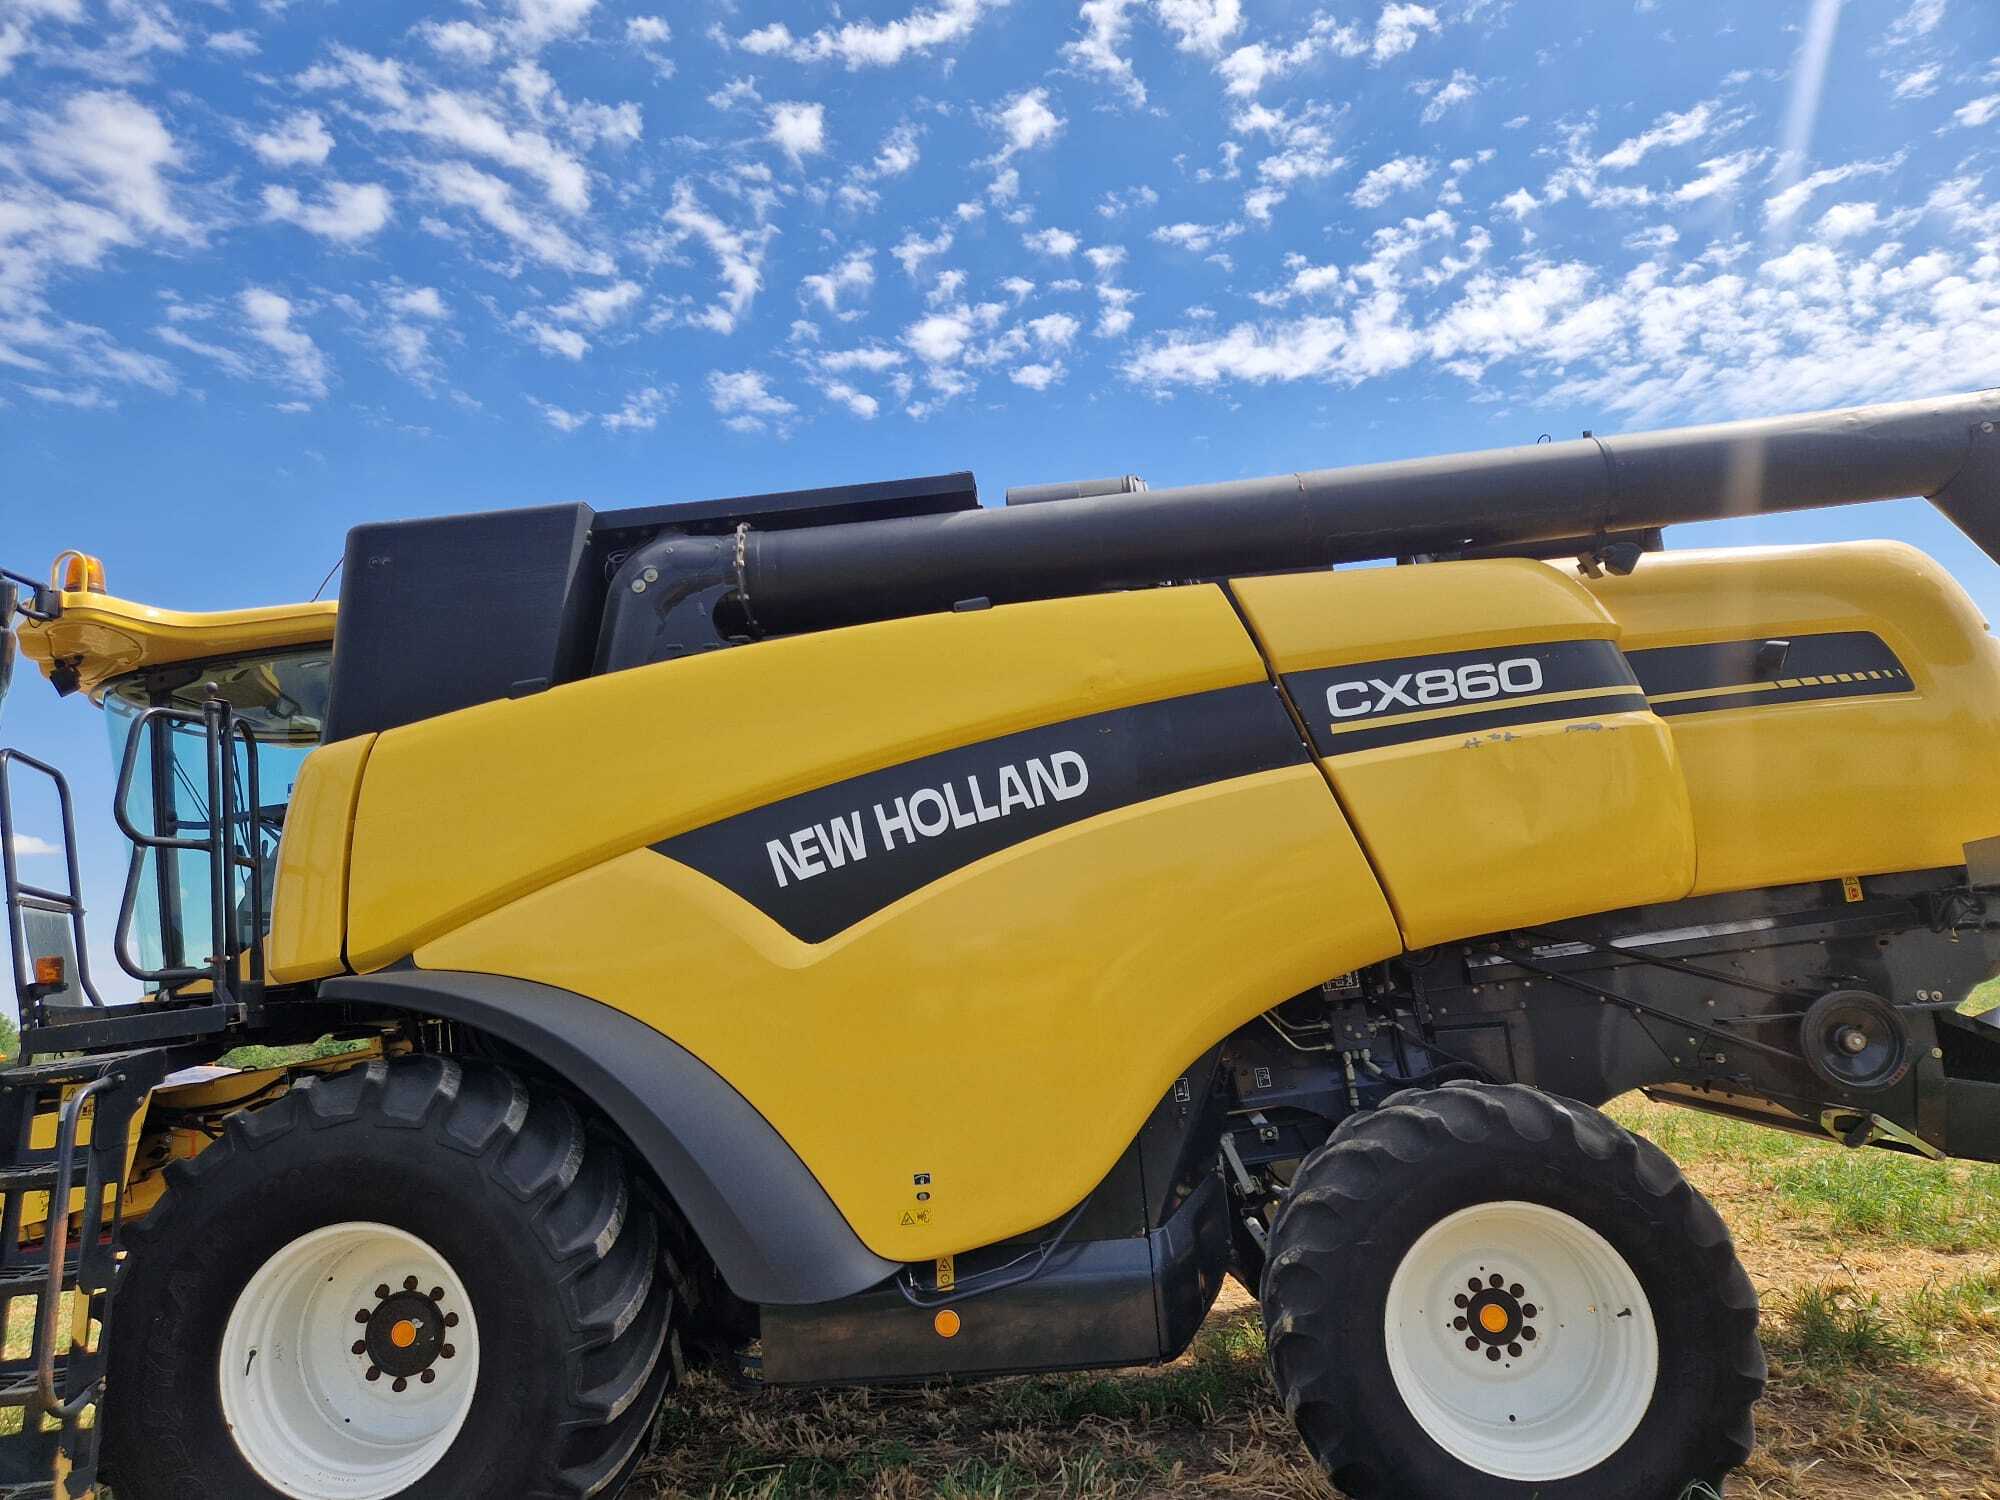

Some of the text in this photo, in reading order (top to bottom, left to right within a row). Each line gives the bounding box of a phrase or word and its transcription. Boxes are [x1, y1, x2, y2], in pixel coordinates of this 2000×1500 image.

[1326, 658, 1543, 717] CX860
[766, 750, 1089, 887] NEW HOLLAND
